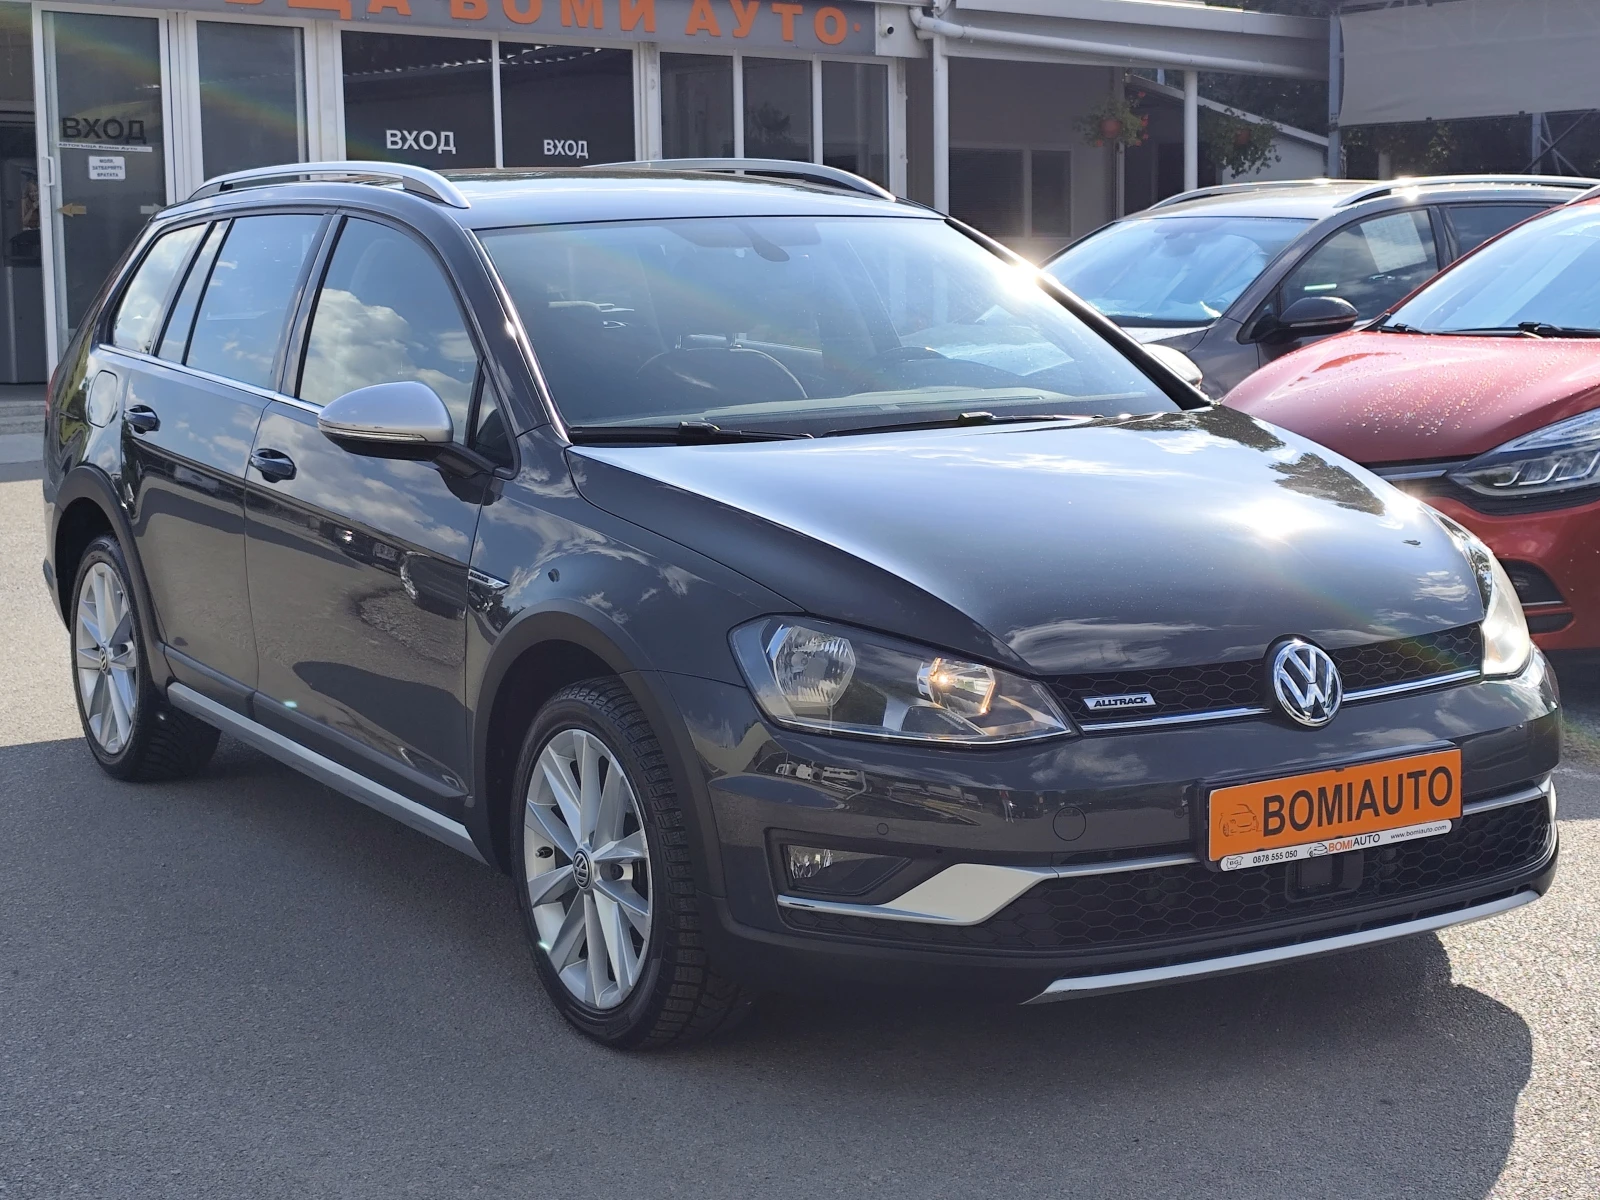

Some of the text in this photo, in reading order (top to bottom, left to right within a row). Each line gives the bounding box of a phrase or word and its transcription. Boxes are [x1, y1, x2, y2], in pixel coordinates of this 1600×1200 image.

[685, 1, 849, 45] АУТО
[62, 117, 147, 145] ВХОД
[386, 129, 457, 155] ВХОД
[543, 139, 589, 159] ВХОД
[1093, 696, 1148, 708] ALLTRACK
[1263, 766, 1453, 838] BOMIAUTO
[1390, 824, 1447, 840] www.bomiauto.com
[1328, 833, 1381, 853] BOMIAUTO
[1252, 849, 1298, 864] 0878 555 050
